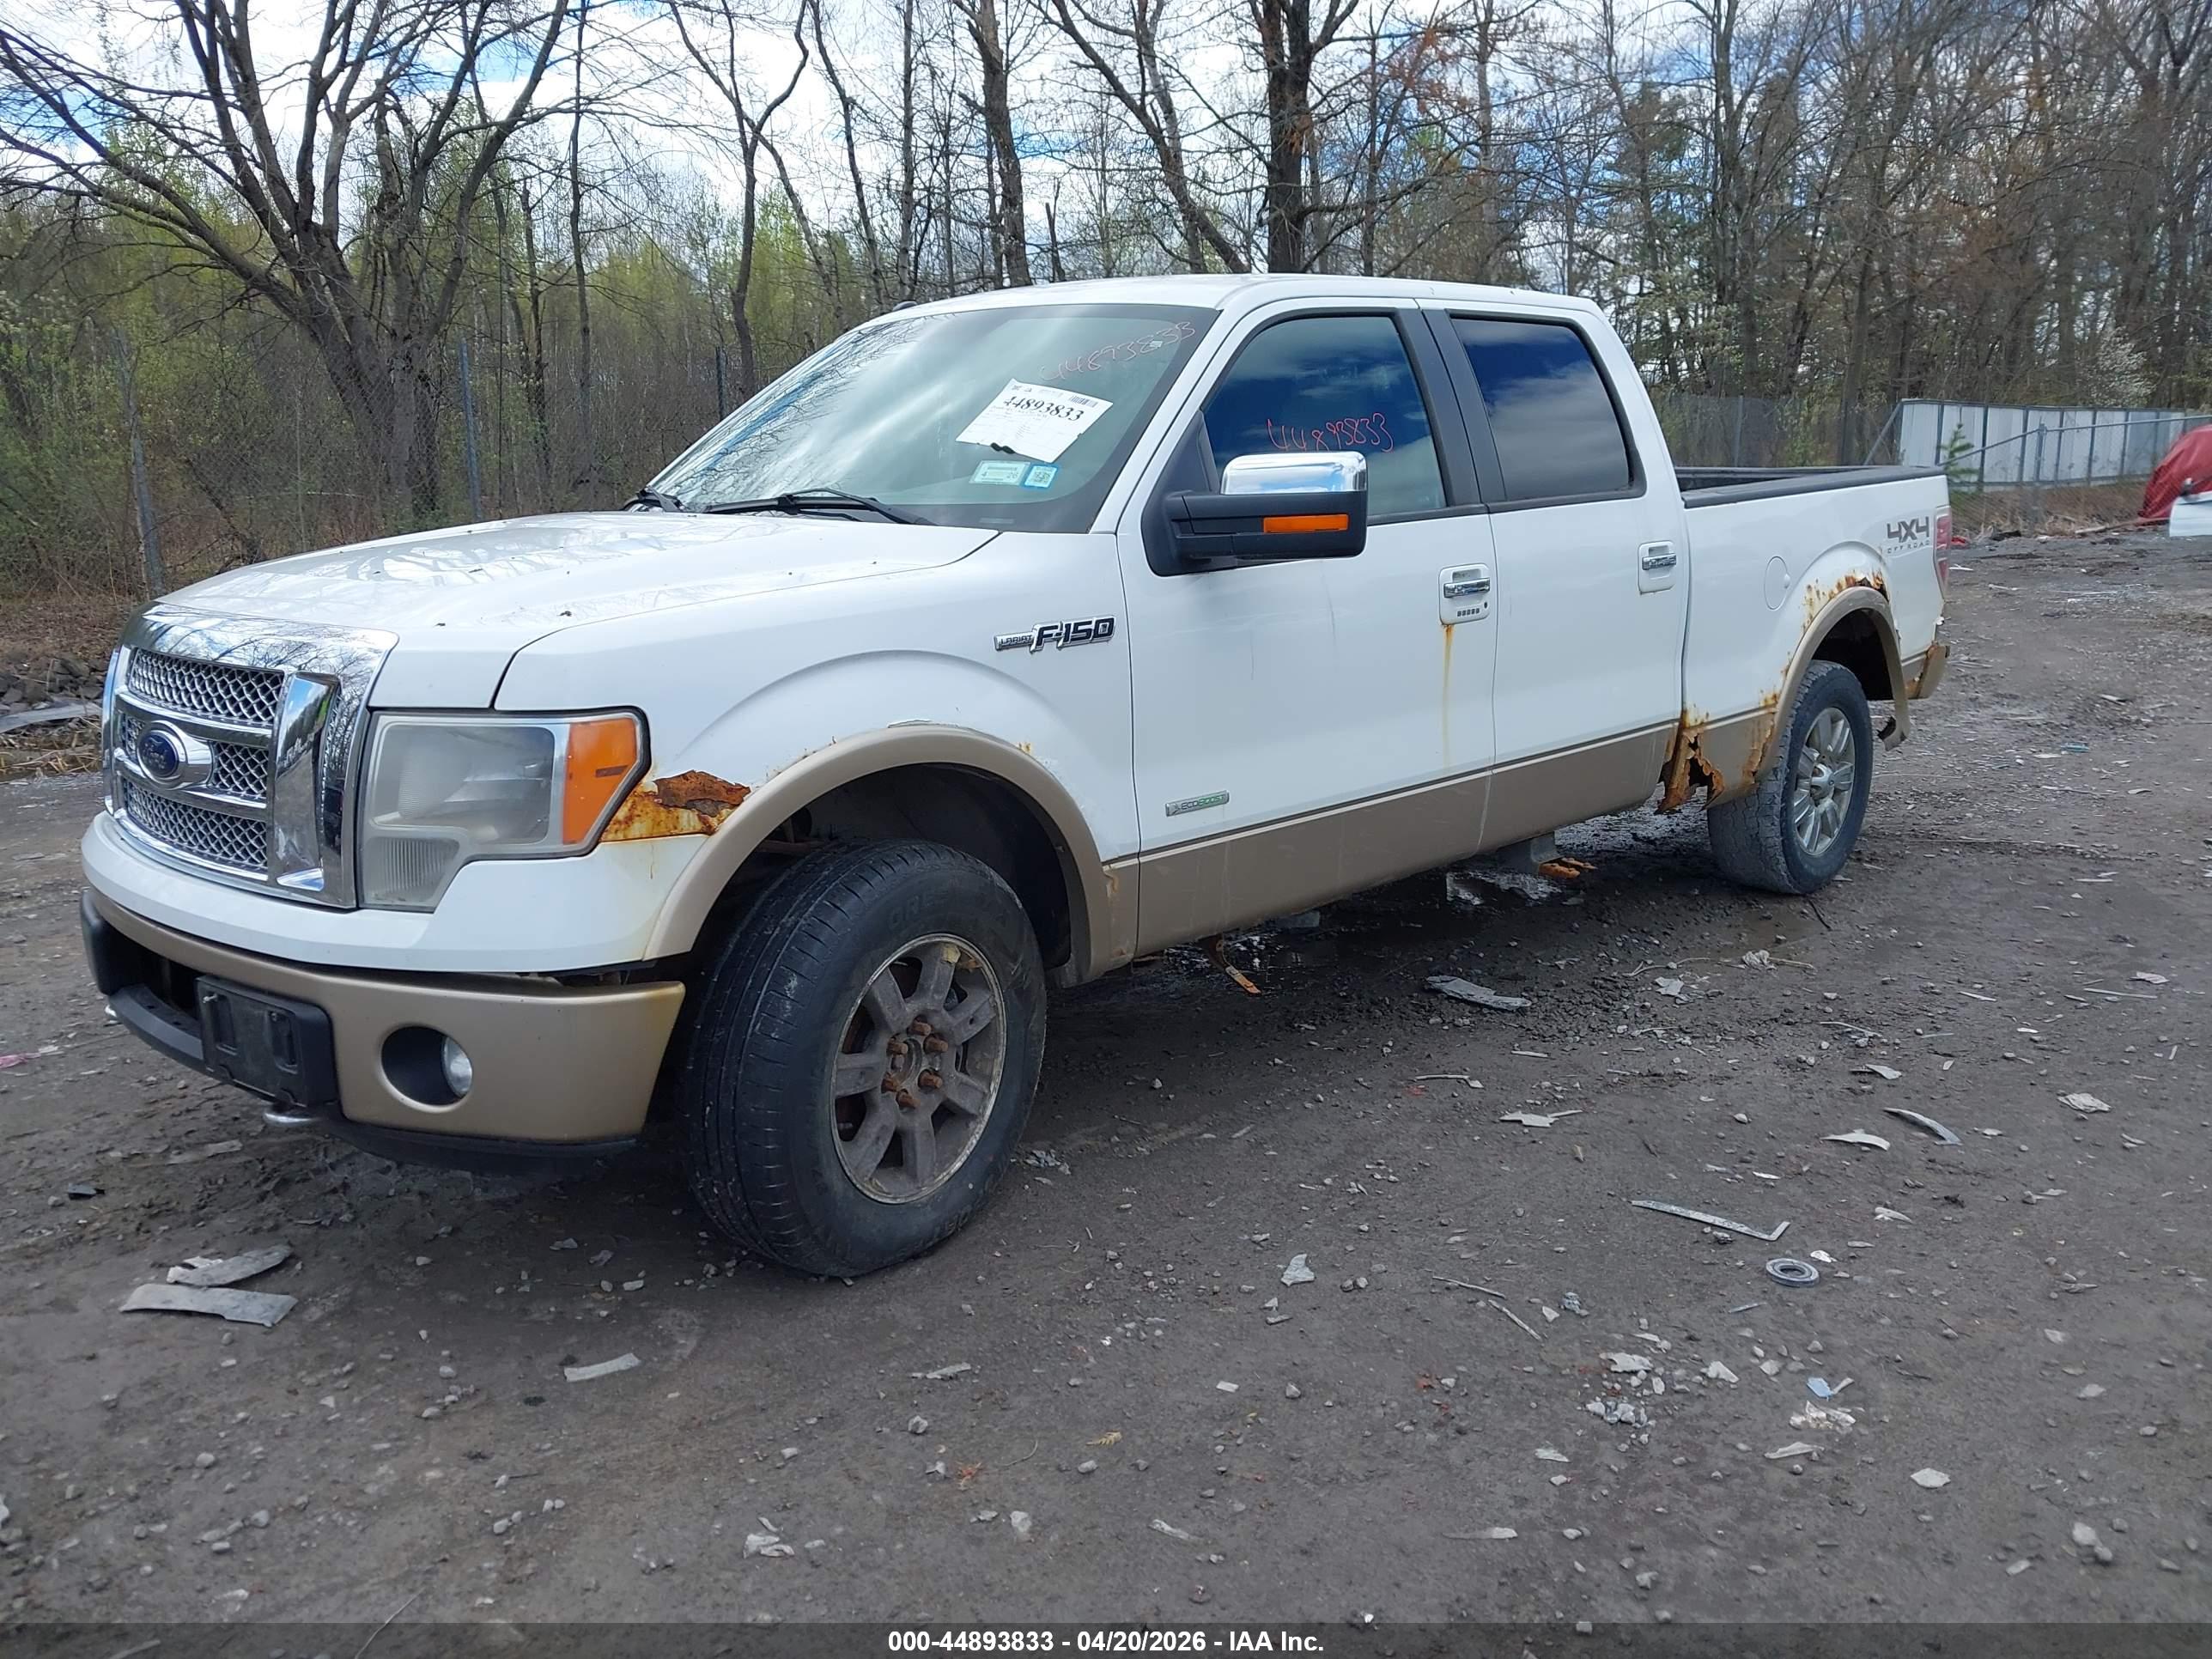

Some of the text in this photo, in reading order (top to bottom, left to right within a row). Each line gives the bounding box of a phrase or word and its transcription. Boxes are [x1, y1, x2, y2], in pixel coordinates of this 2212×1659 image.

[1004, 396, 1084, 421] 44893833
[1267, 412, 1394, 453] 44893833
[1034, 616, 1115, 649] F-150
